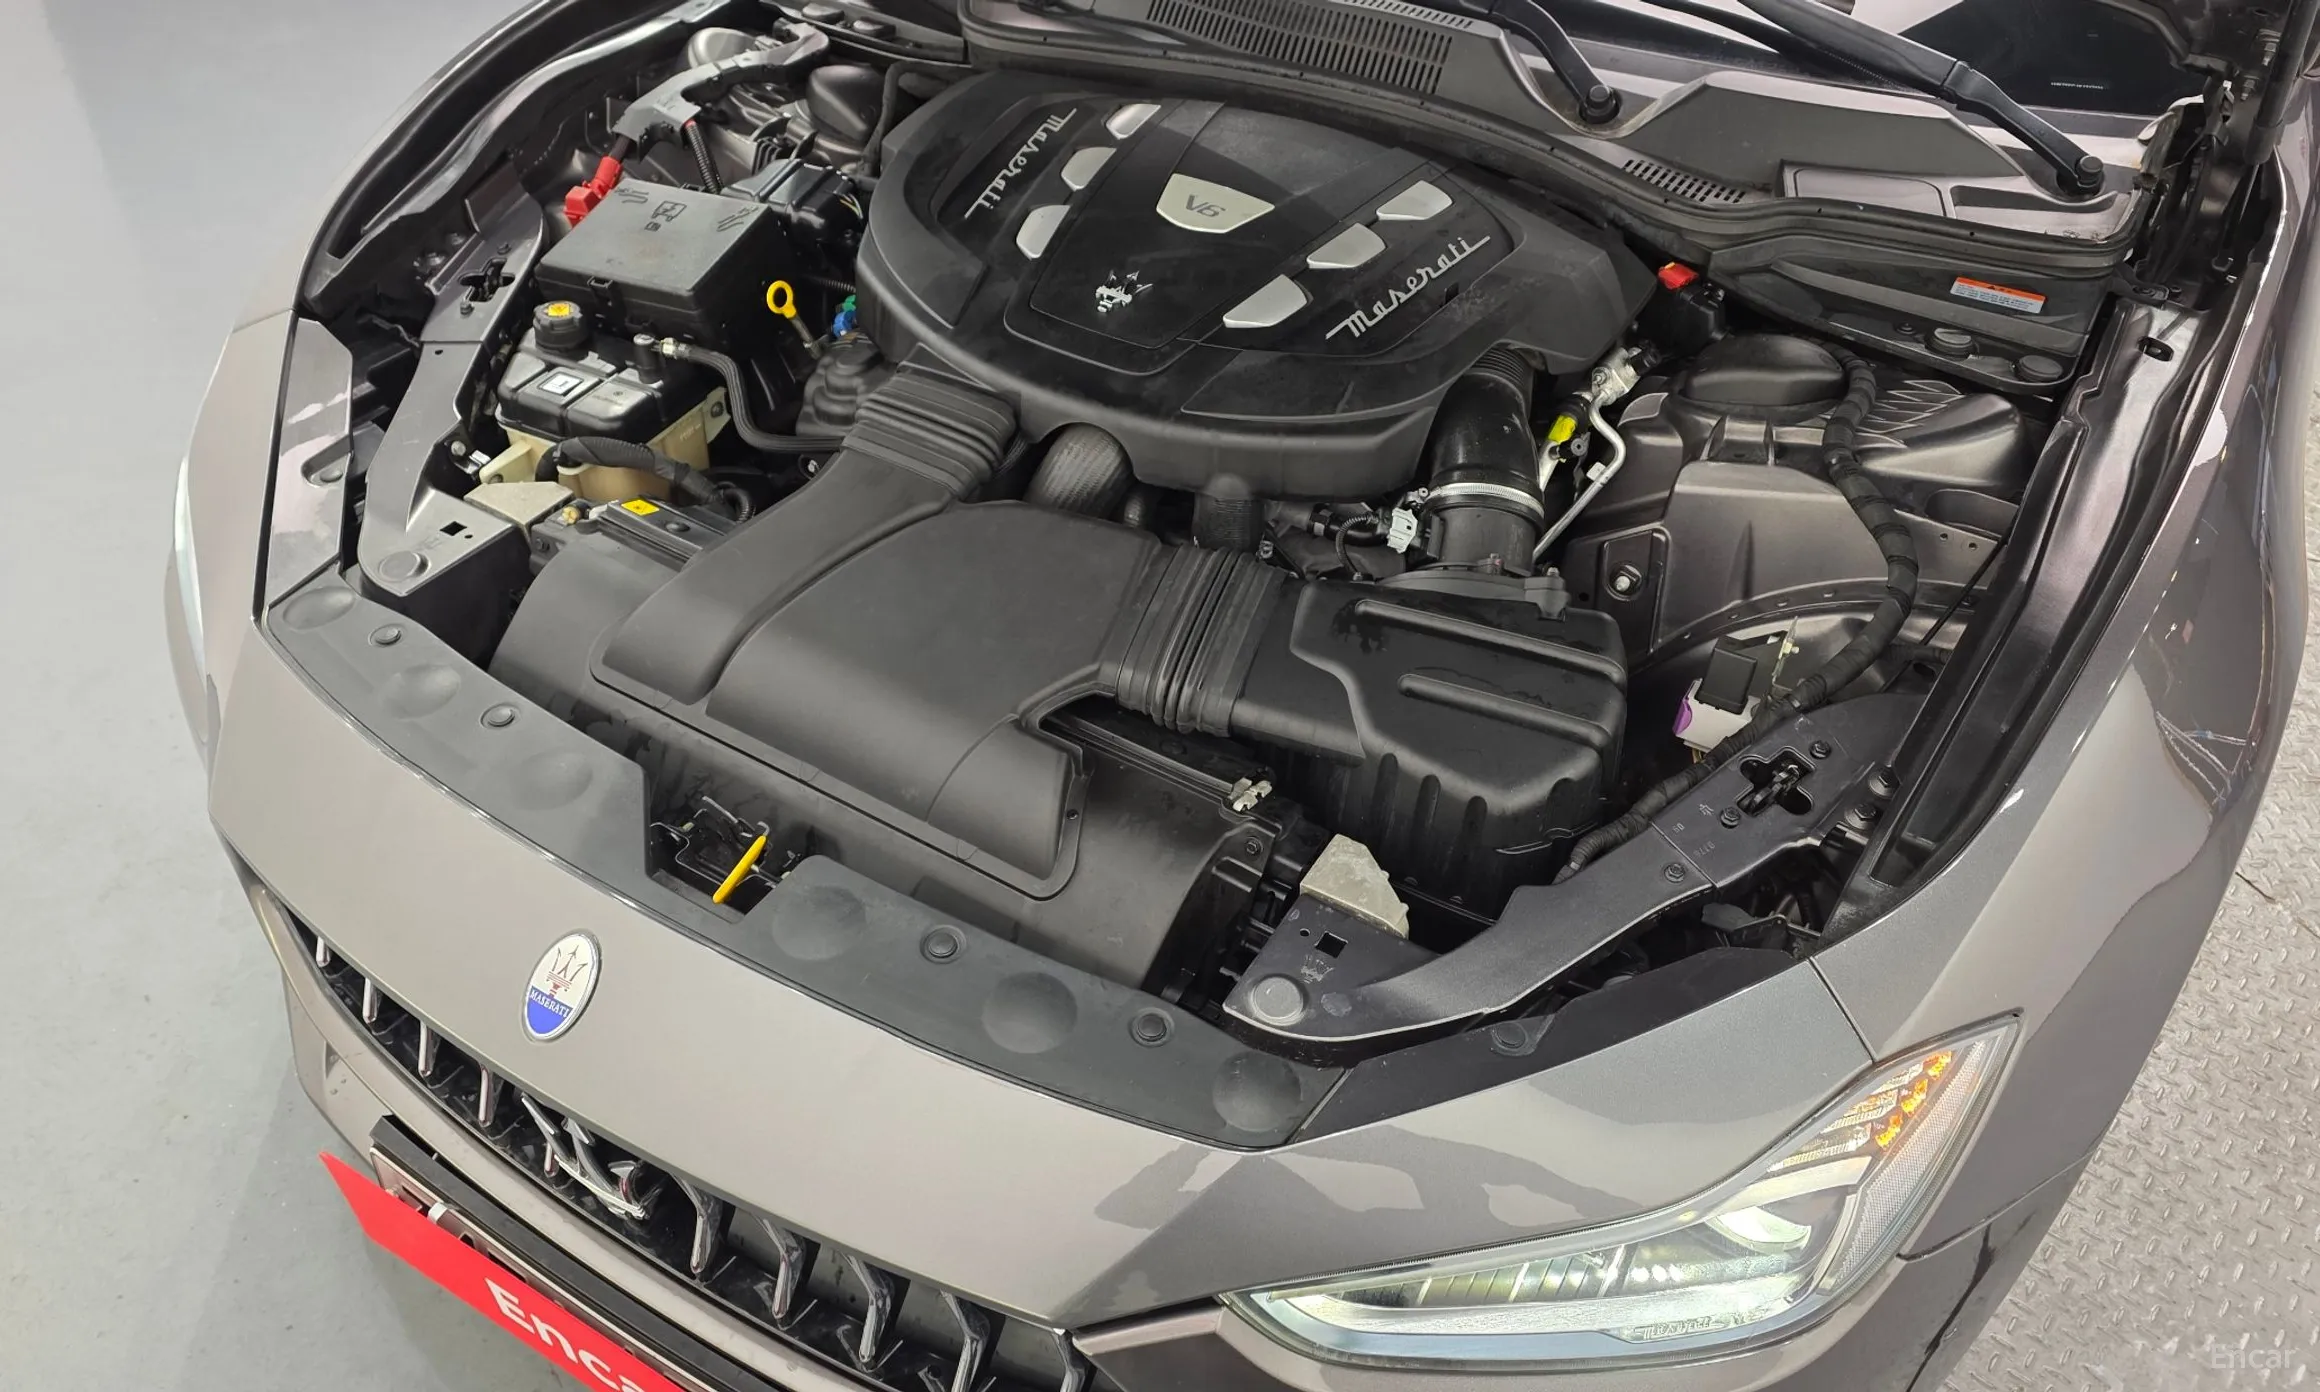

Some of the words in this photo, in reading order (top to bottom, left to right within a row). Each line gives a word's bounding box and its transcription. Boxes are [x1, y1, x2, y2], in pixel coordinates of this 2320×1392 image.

[964, 107, 1078, 219] Maserati
[1185, 194, 1227, 218] V6
[1325, 235, 1491, 340] Maserati
[529, 989, 570, 1018] MASERATI
